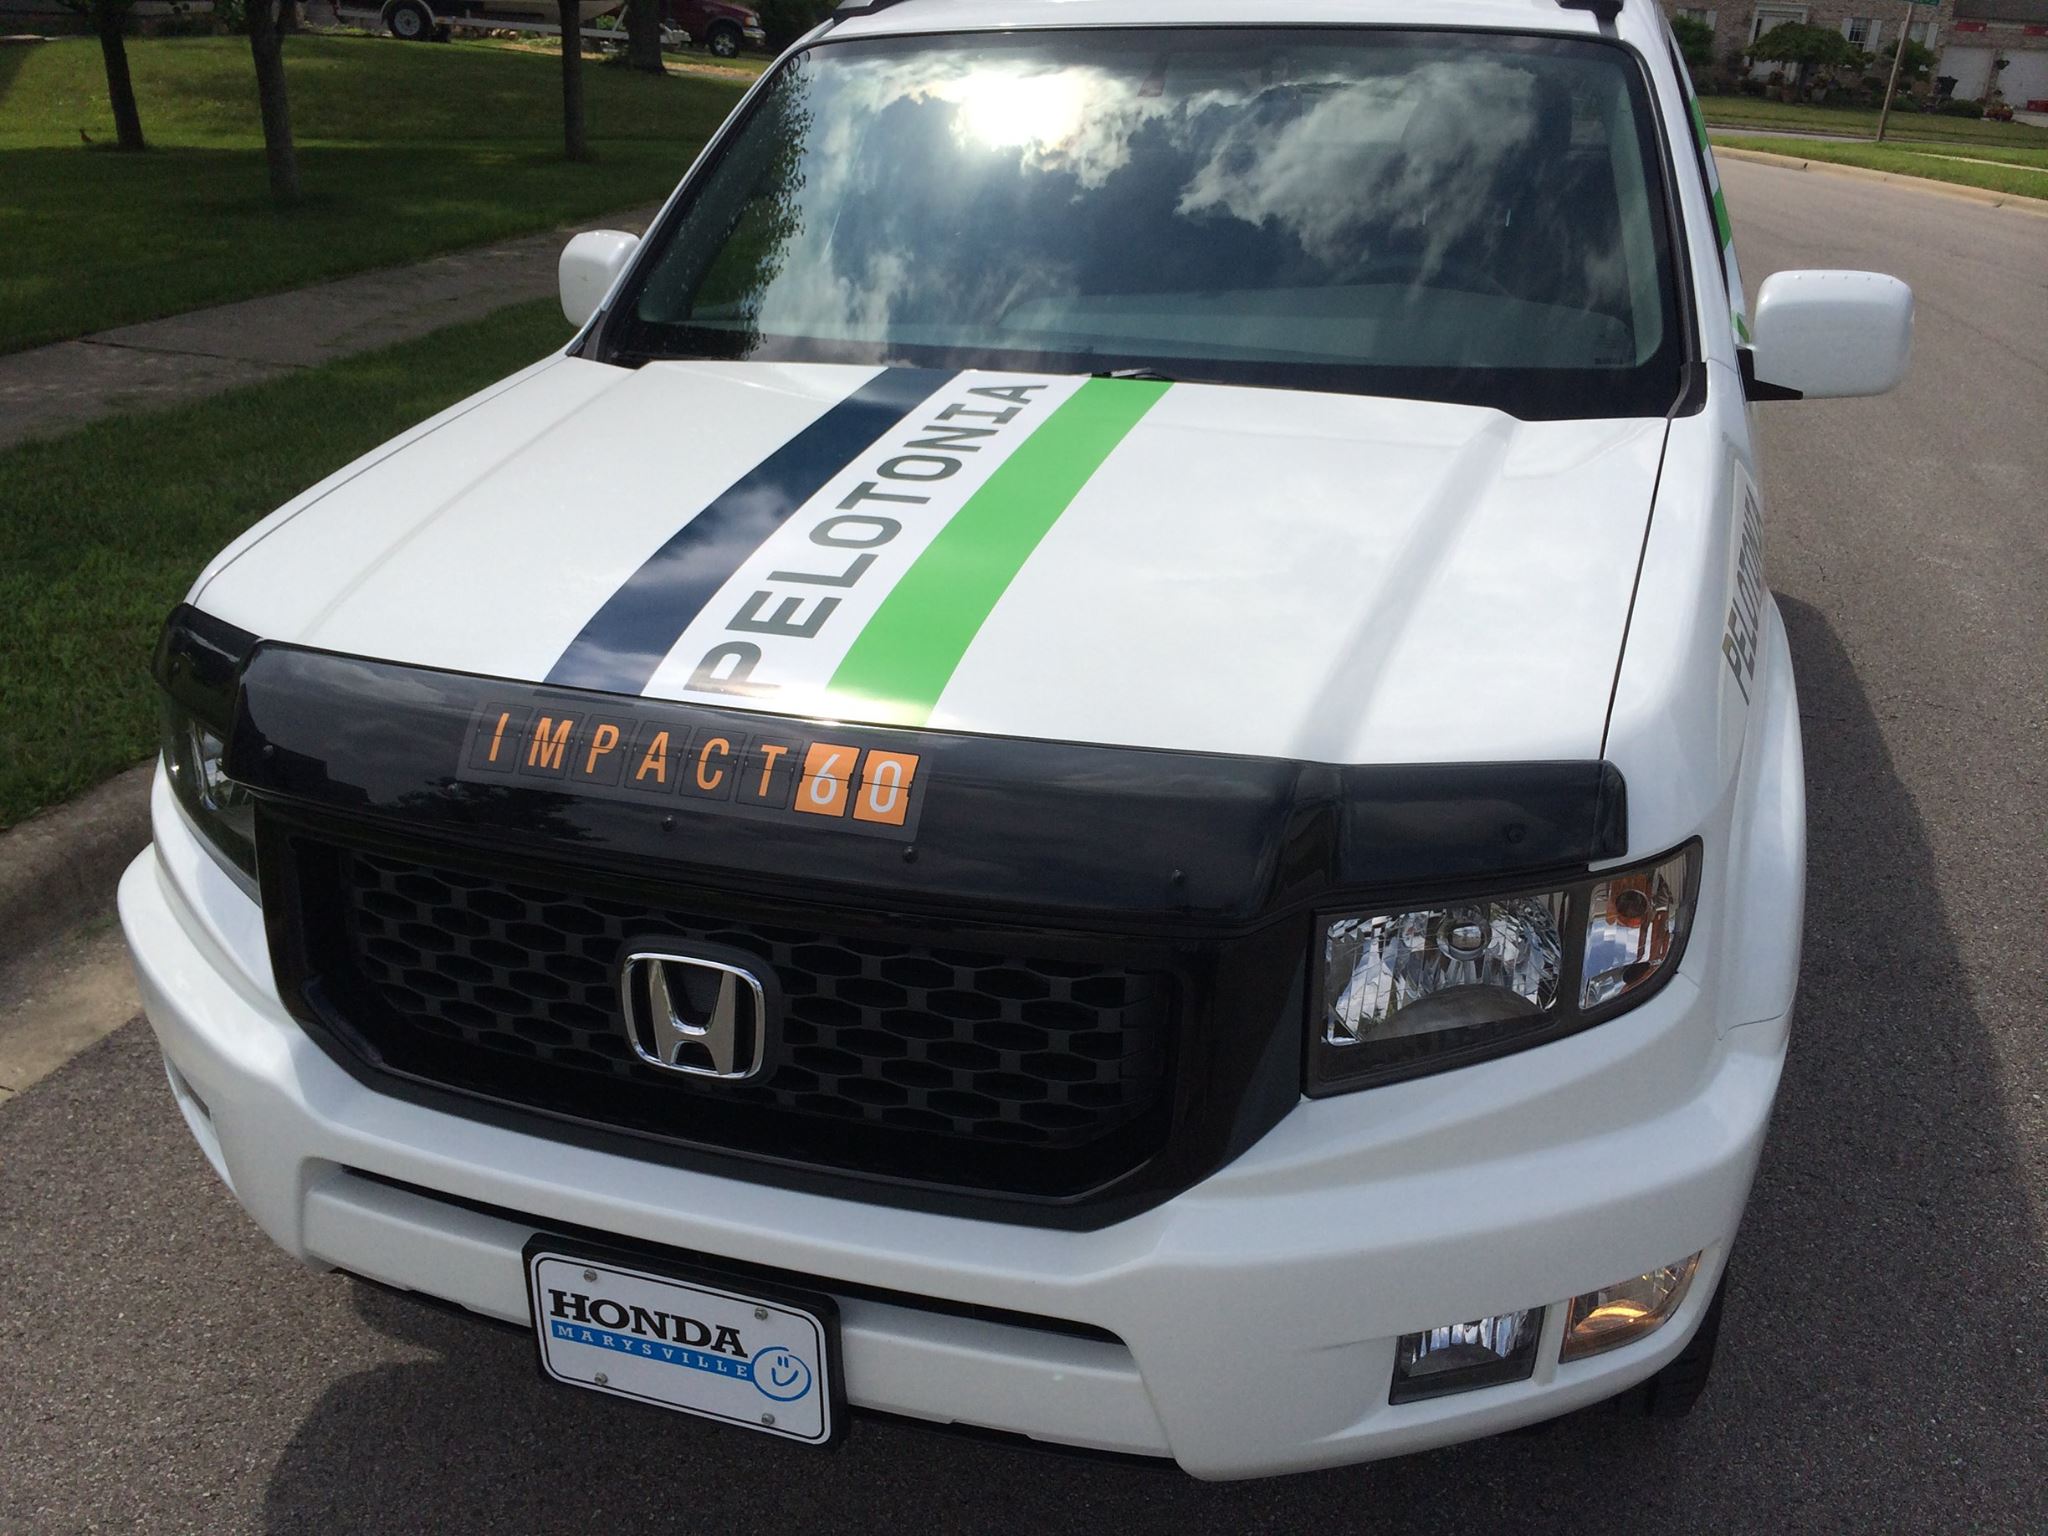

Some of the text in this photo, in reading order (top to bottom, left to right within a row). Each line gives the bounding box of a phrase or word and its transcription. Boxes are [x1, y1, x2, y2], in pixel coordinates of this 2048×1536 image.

[683, 384, 1049, 698] PELOTONIA
[548, 1289, 749, 1358] HONDA
[557, 1324, 748, 1378] MARYSVILLE
